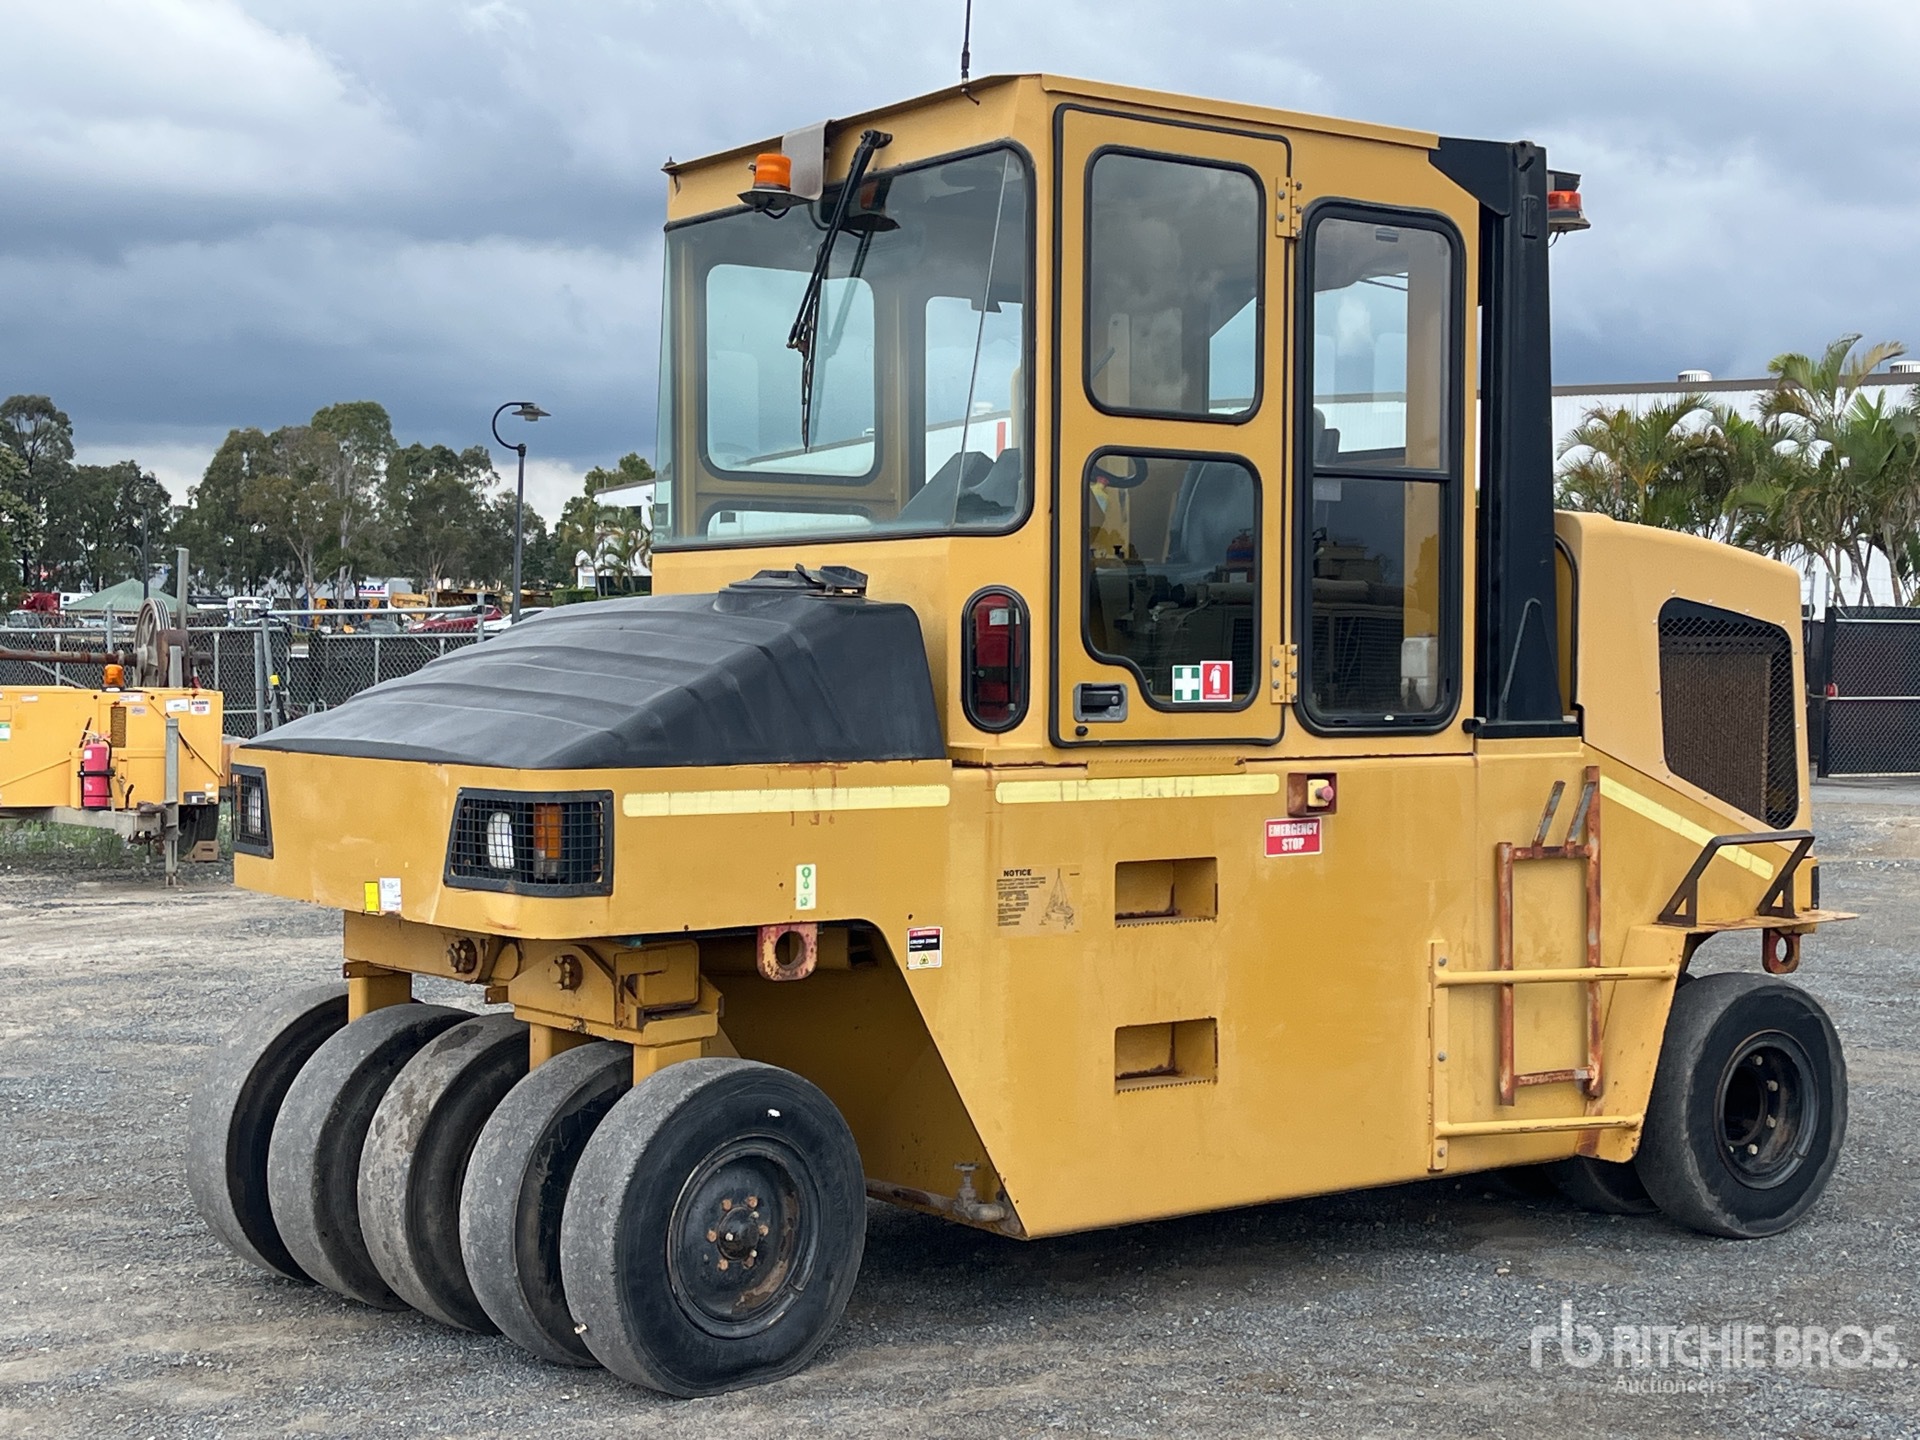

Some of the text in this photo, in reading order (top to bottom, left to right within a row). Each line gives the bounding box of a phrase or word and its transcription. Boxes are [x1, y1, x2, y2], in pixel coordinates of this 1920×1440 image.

[1268, 823, 1318, 837] EMERGENCY
[1281, 838, 1305, 851] STOP
[1003, 869, 1032, 877] NOTICE
